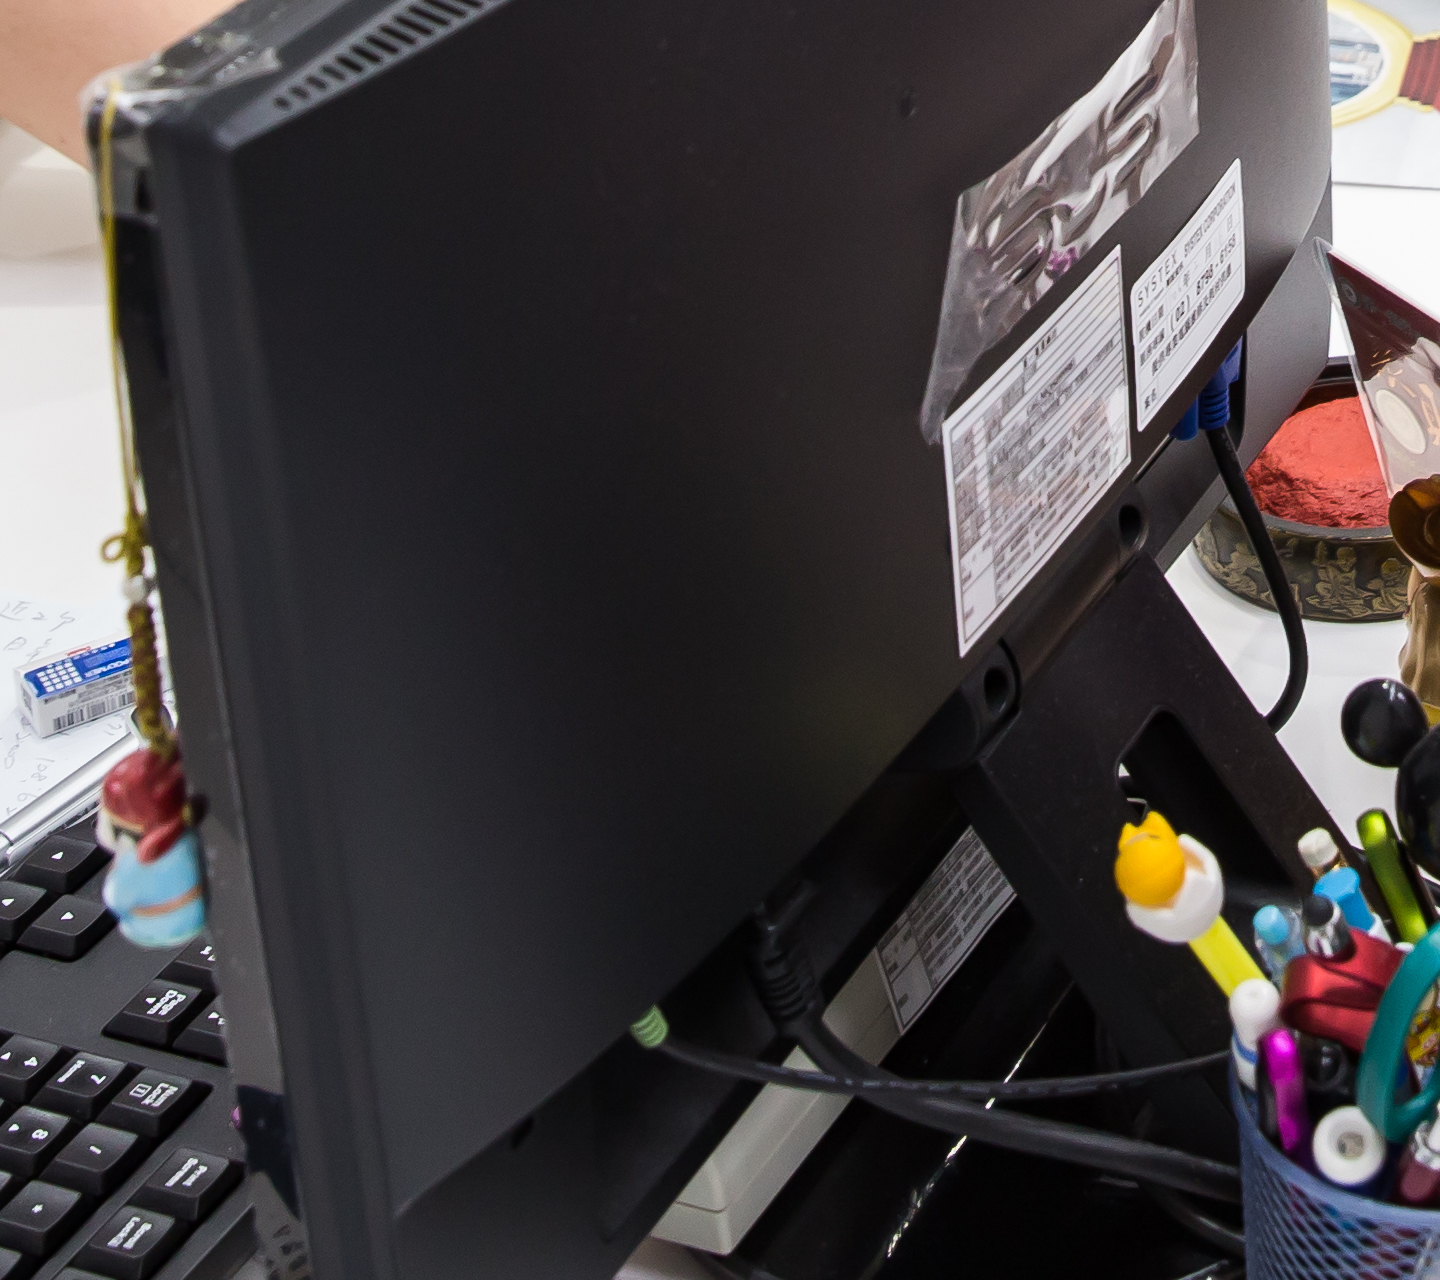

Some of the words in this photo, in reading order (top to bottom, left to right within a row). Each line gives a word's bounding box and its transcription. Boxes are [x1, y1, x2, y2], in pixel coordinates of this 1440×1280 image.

[1138, 252, 1178, 308] SYSTEX
[147, 989, 178, 1014] Down
[158, 993, 187, 1015] Page
[31, 1128, 49, 1140] 8
